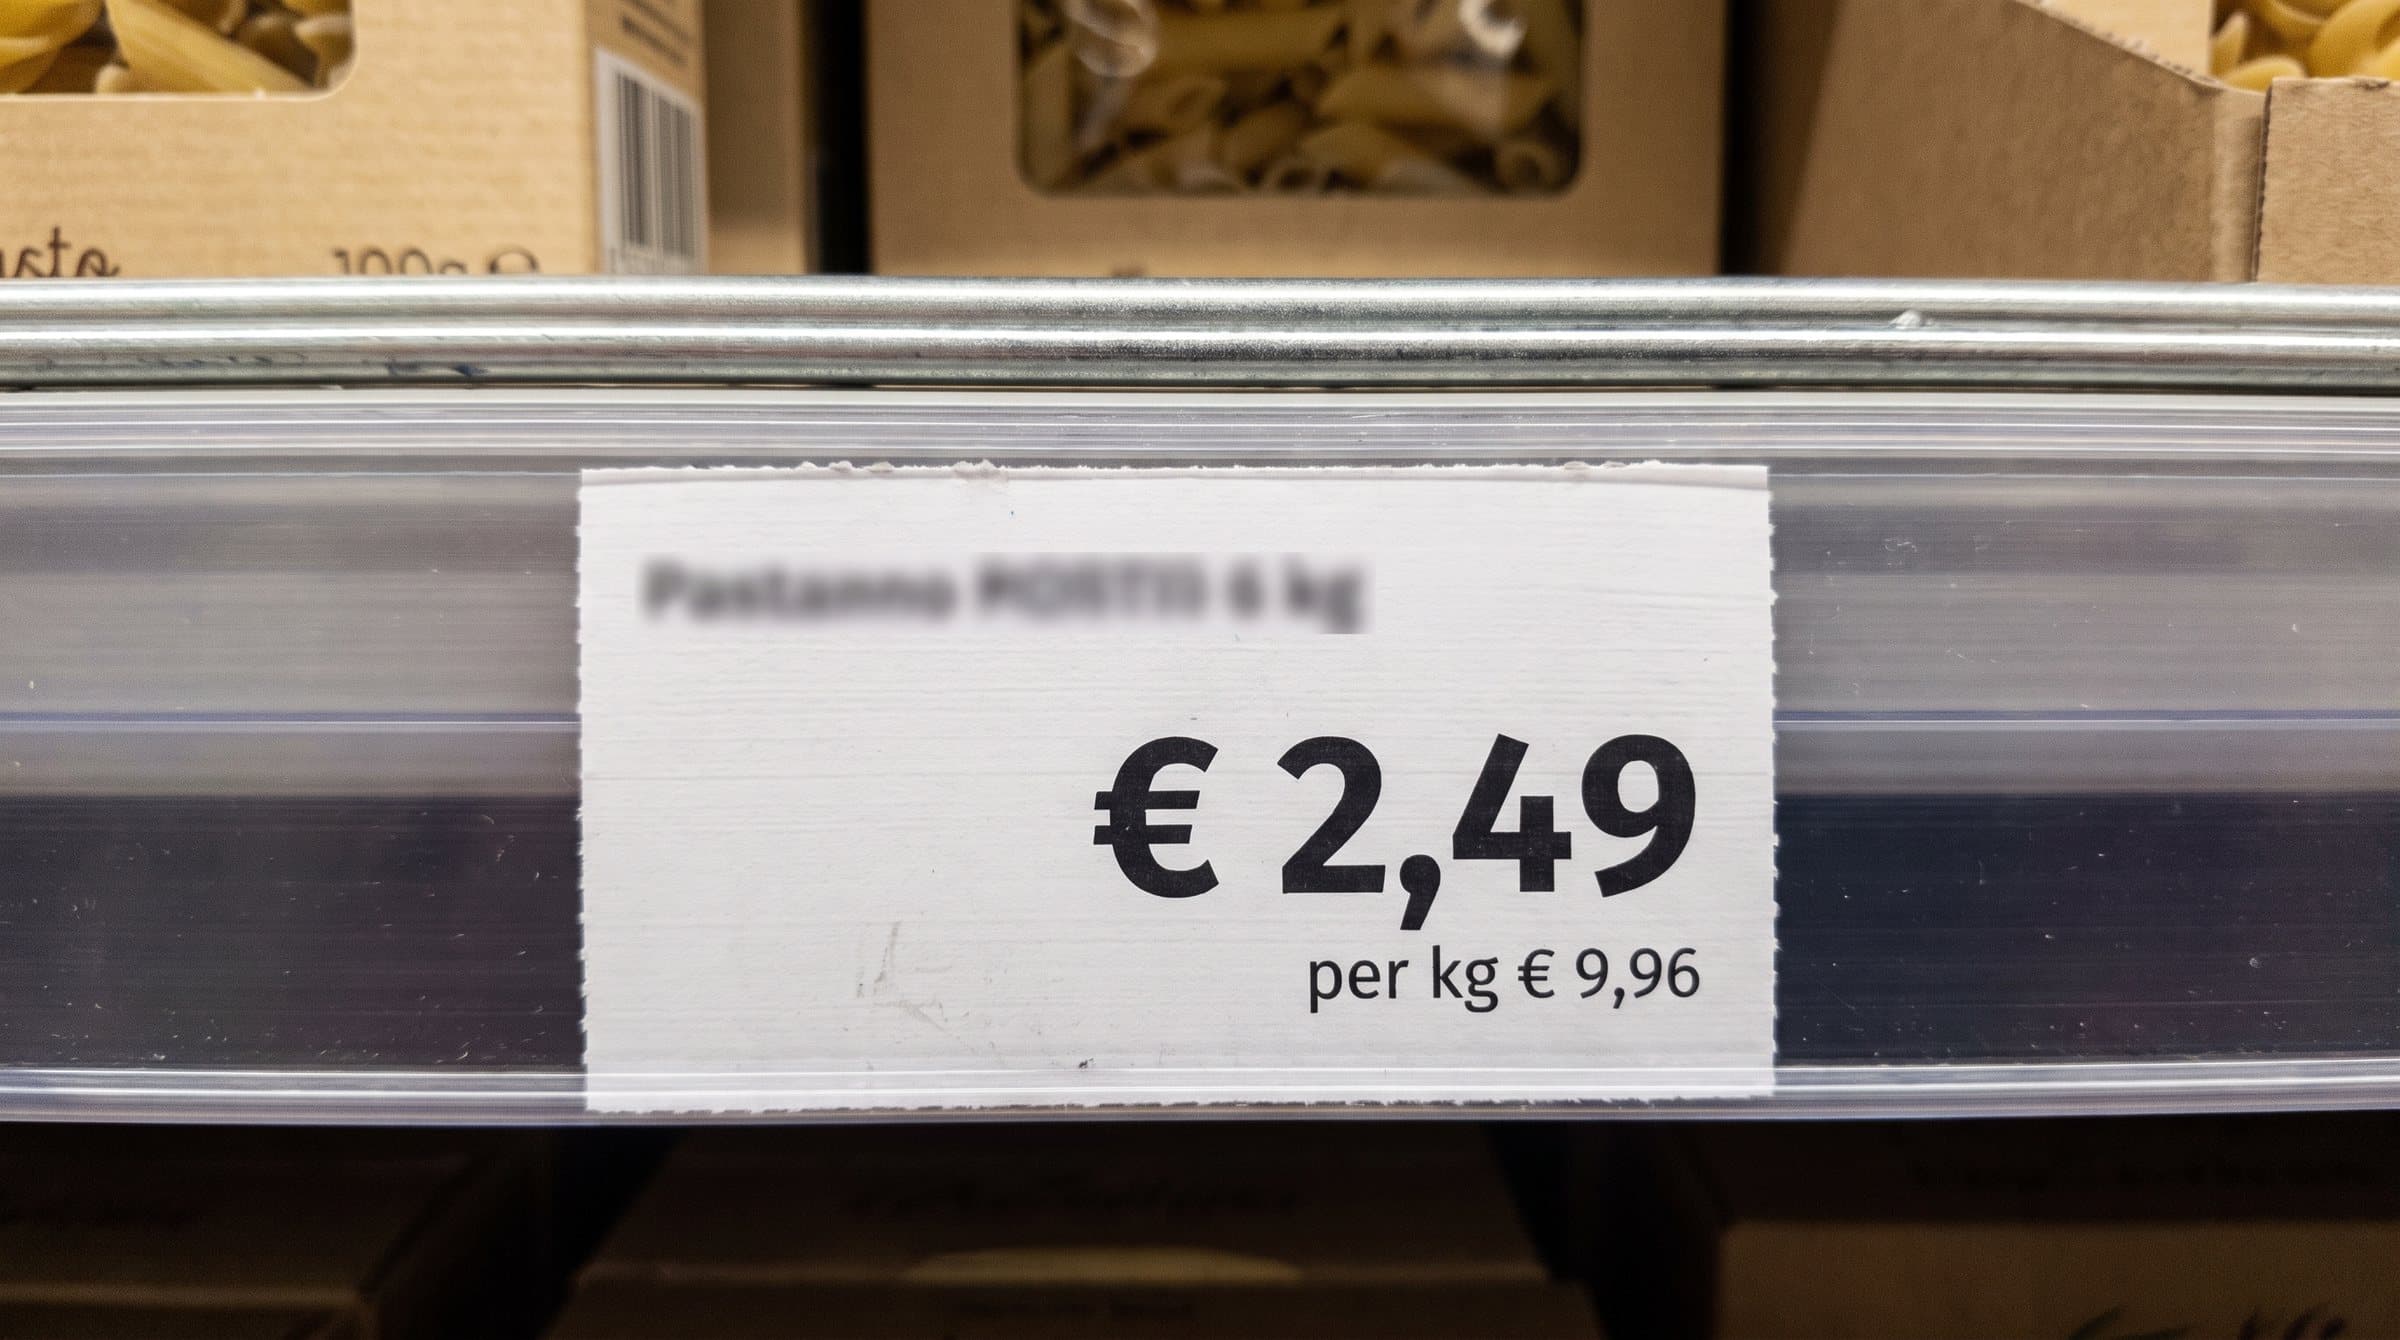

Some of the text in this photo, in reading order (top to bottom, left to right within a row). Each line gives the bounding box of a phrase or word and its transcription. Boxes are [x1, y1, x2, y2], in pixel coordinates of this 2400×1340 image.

[1094, 734, 1695, 930] € 2,49
[1309, 945, 1700, 1013] per kg € 9,96
